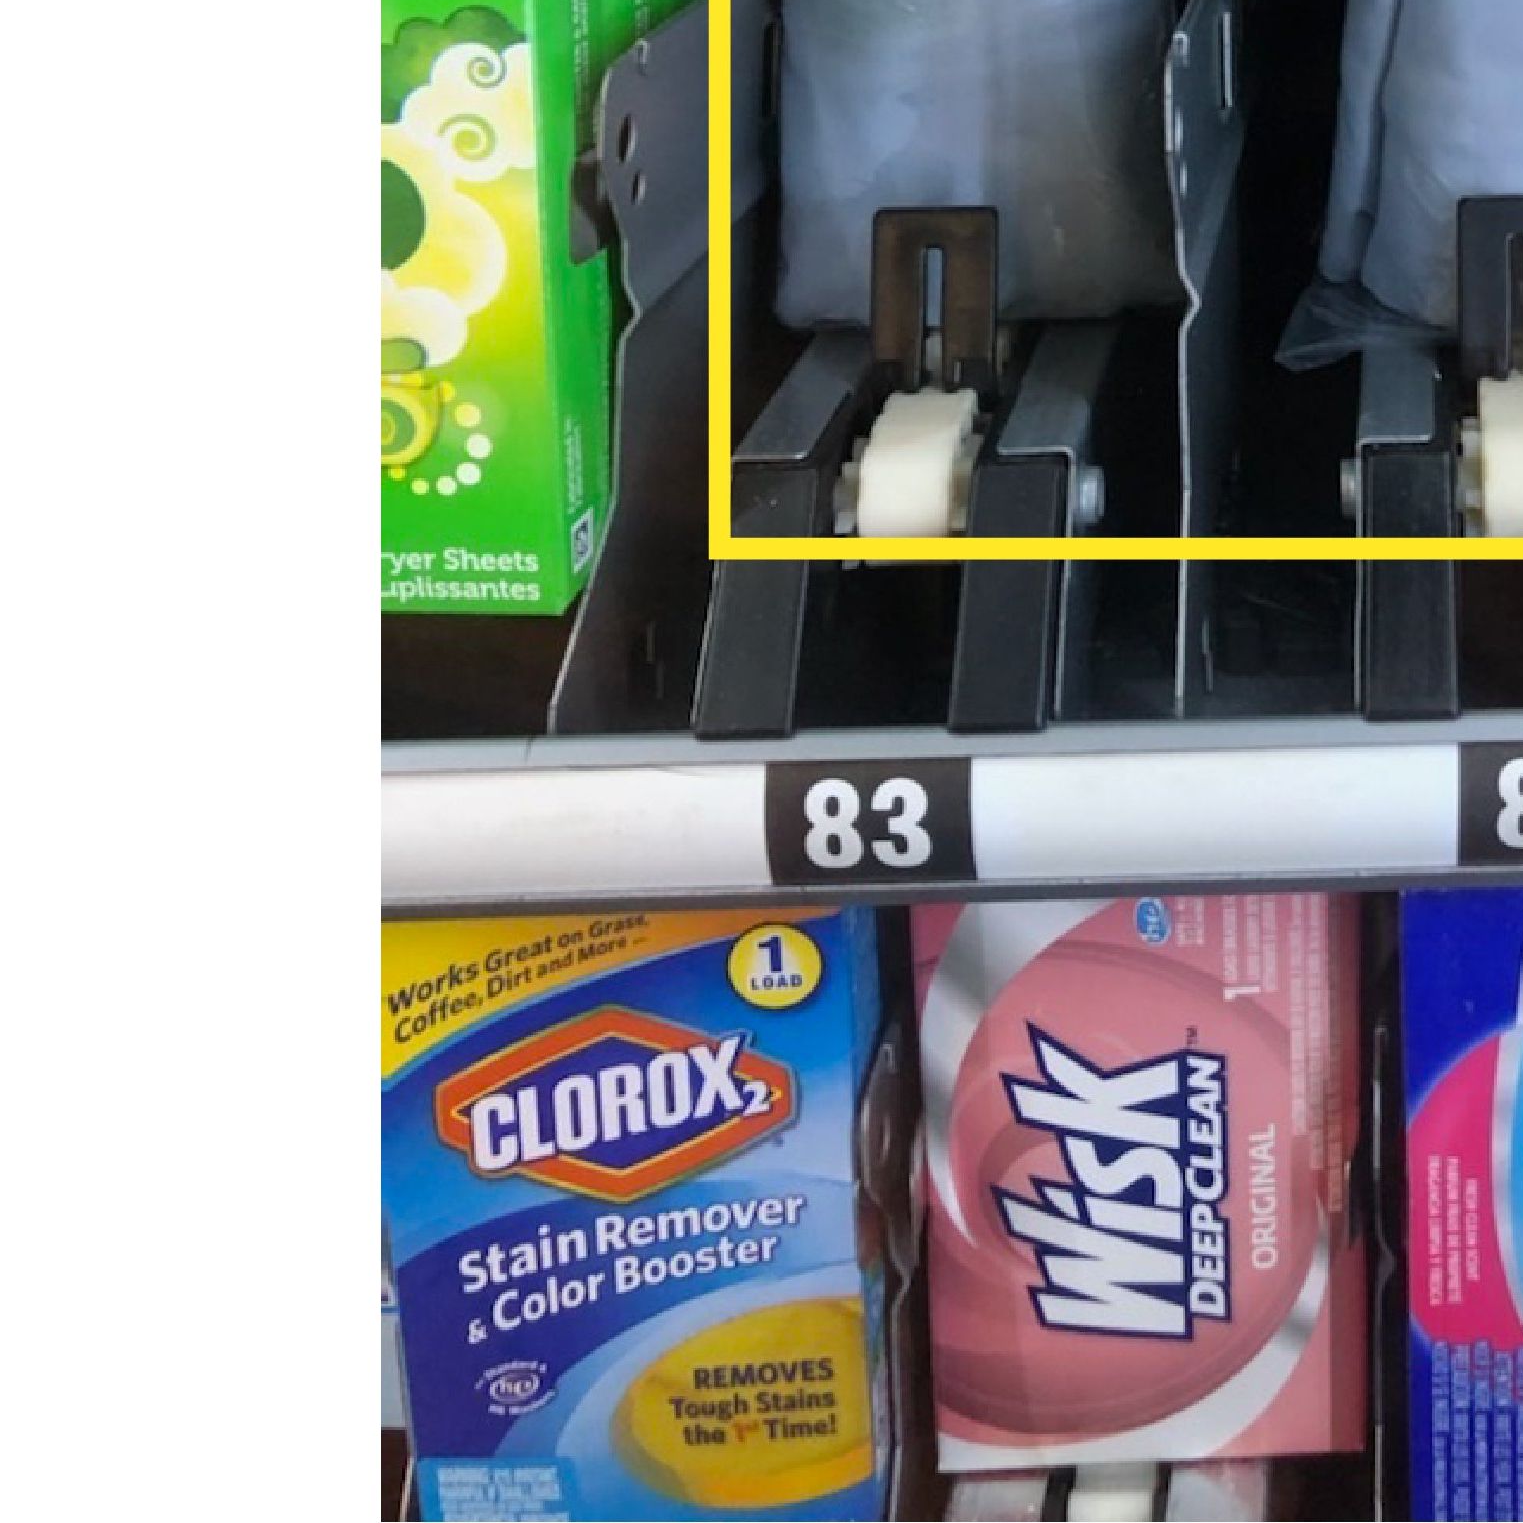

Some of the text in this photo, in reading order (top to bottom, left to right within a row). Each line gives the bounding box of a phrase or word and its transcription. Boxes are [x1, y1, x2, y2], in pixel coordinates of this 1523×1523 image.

[442, 546, 540, 572] Sheets
[802, 776, 934, 870] 83
[388, 962, 480, 1015] Works
[483, 933, 553, 976] Great
[557, 929, 587, 951] on
[393, 934, 629, 1045] Coffee, Dirt and More
[749, 974, 804, 991] LOAD
[757, 935, 785, 974] 1
[991, 1020, 1193, 1340] Wisk
[1250, 1122, 1281, 1270] ORIGINAL
[457, 1192, 806, 1295] Stain Remover
[466, 1235, 778, 1345] & Color Booster
[668, 1389, 836, 1421] Tough Stains
[693, 1357, 835, 1391] REMOVES
[682, 1422, 727, 1446] the
[762, 1415, 840, 1441] Time!
